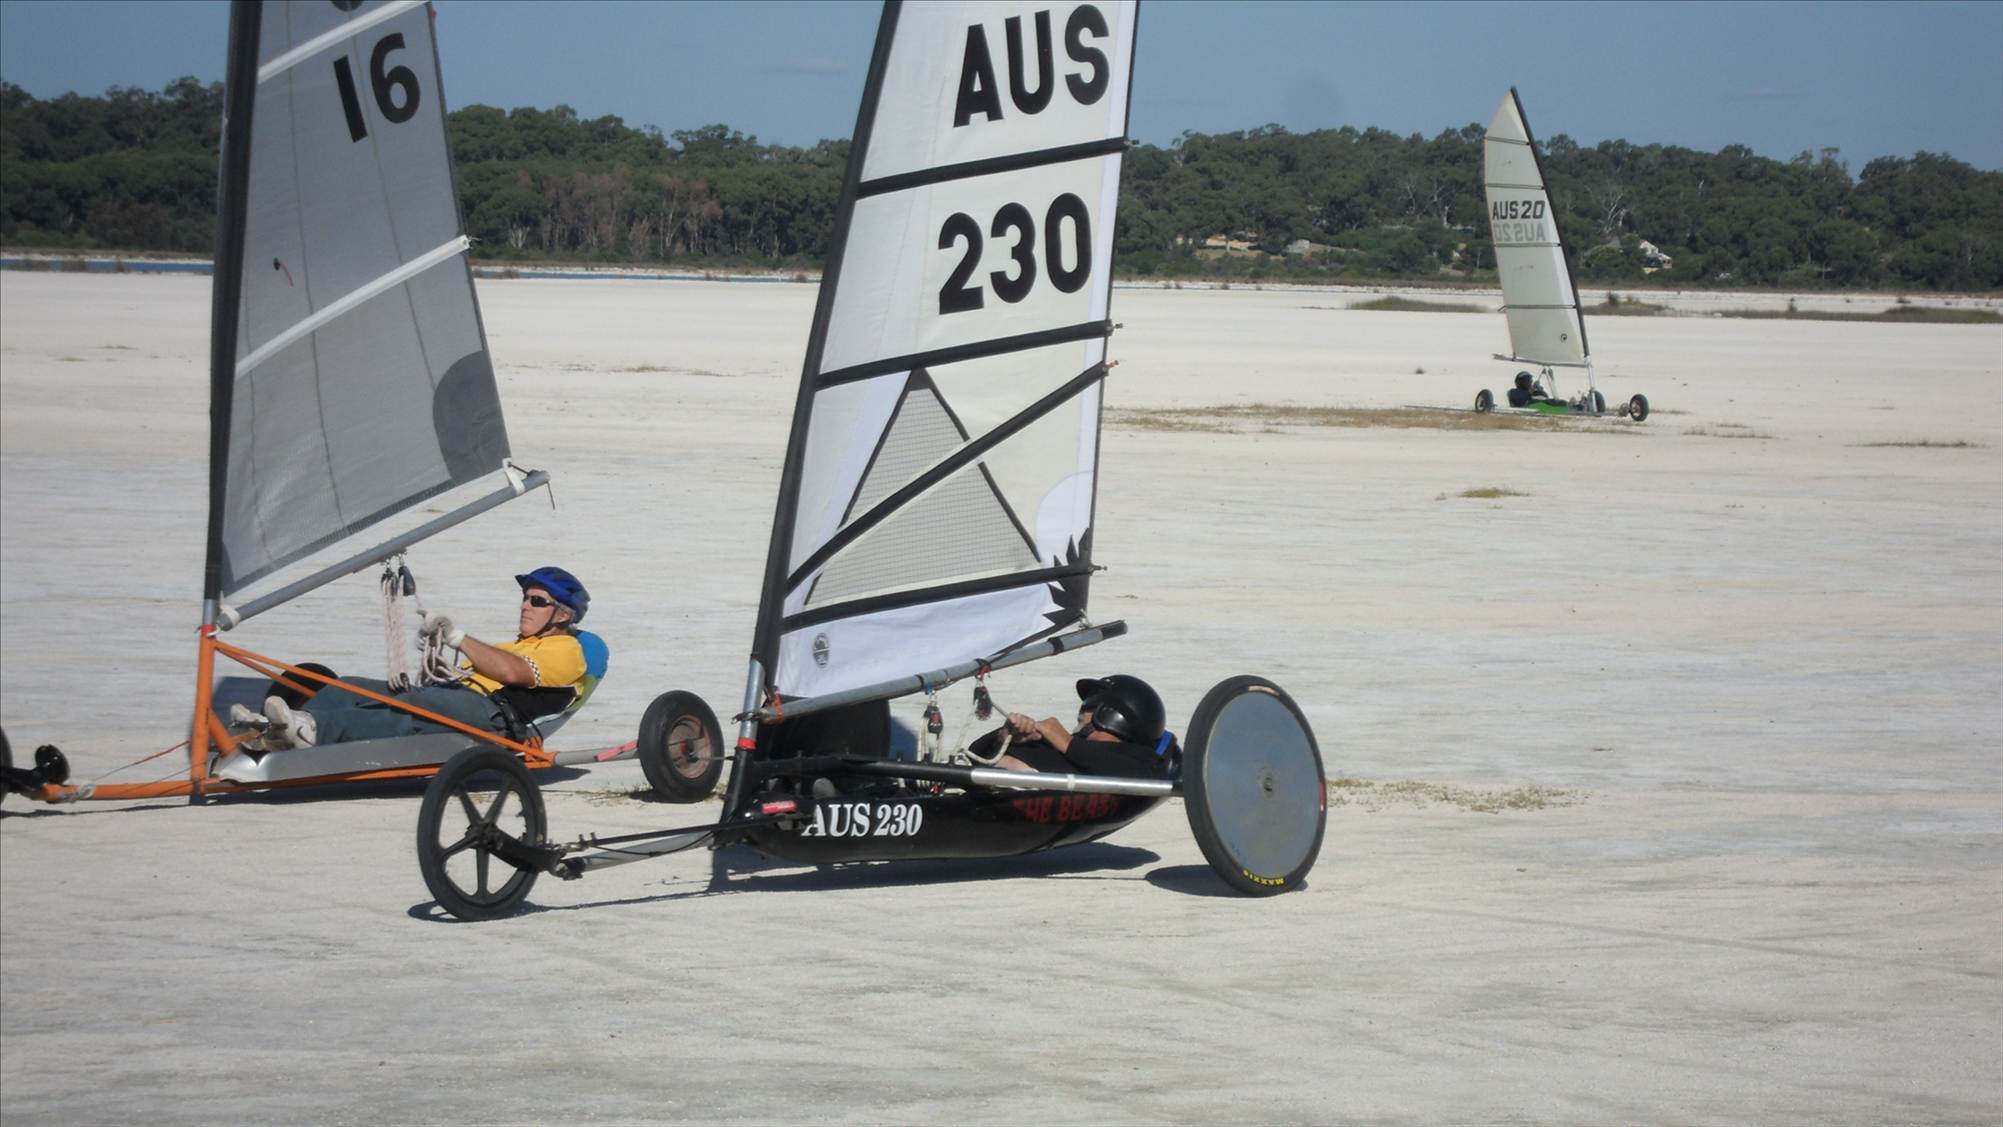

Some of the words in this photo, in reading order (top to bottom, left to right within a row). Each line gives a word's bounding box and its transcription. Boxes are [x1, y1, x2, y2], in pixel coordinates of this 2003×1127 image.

[333, 32, 421, 143] 16
[953, 4, 1110, 128] AUS
[938, 192, 1092, 315] 230
[1493, 201, 1518, 220] AUS
[1521, 201, 1545, 219] 20
[801, 803, 870, 837] AUS
[873, 804, 923, 836] 230
